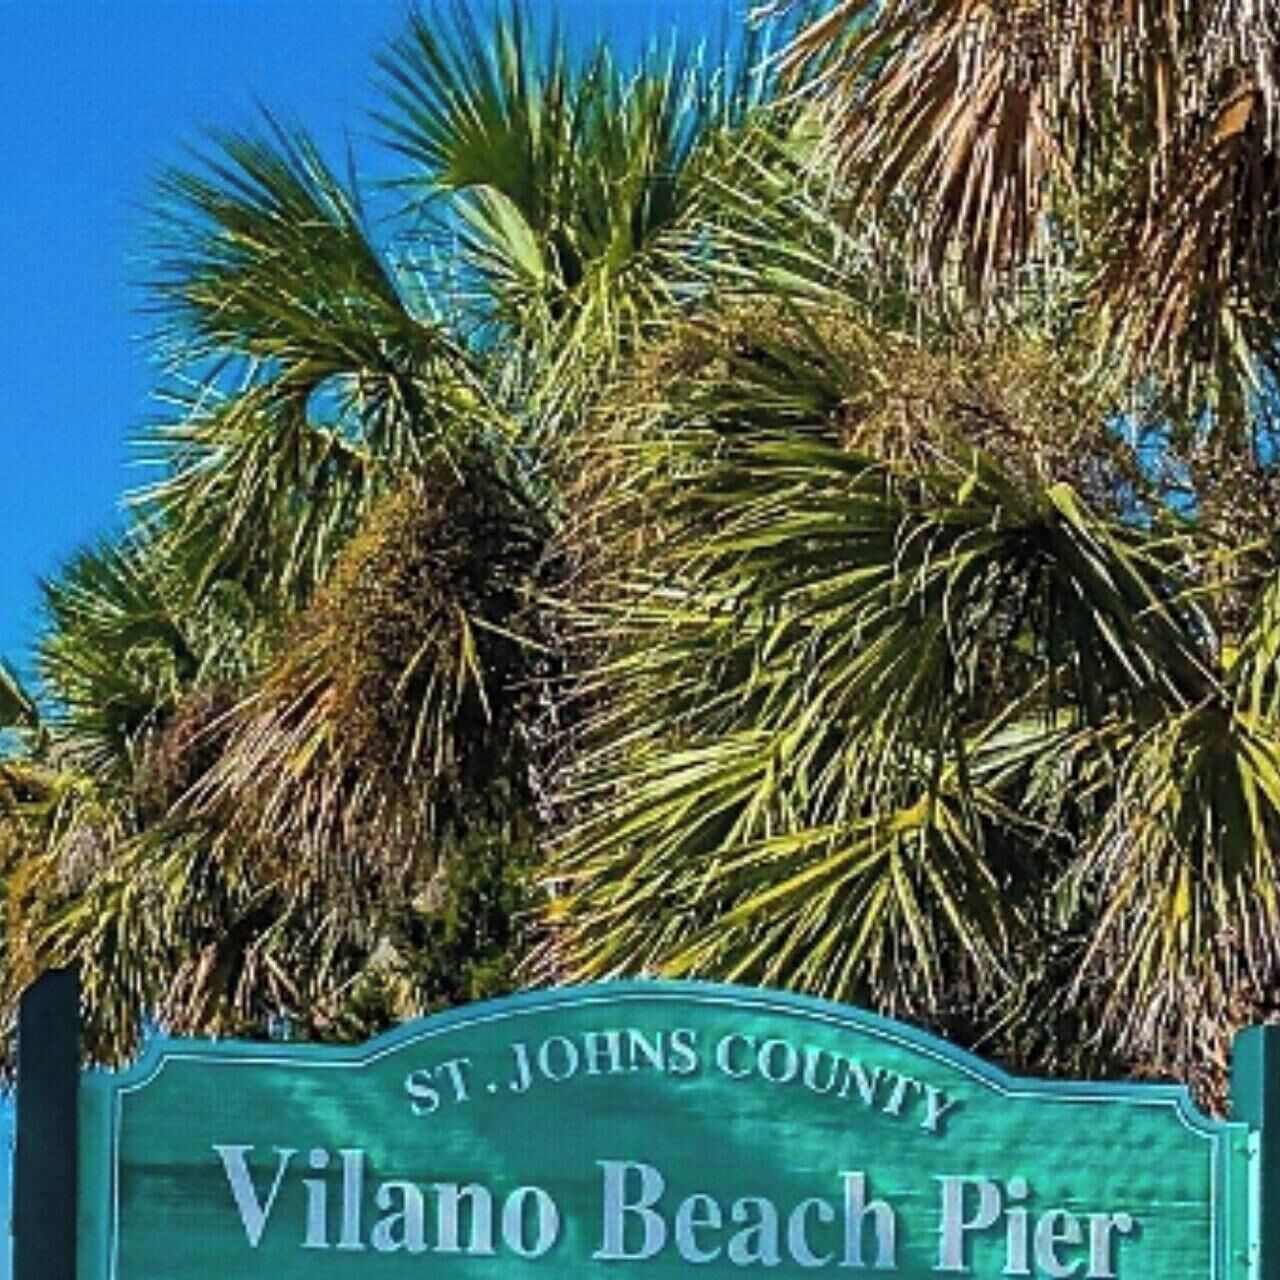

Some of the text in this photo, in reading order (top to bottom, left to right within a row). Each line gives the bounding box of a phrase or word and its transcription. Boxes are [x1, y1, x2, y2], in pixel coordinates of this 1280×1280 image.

[404, 1027, 957, 1132] ST. JOHNS COUNTY
[213, 1145, 1133, 1280] Vilano Beach Pier
